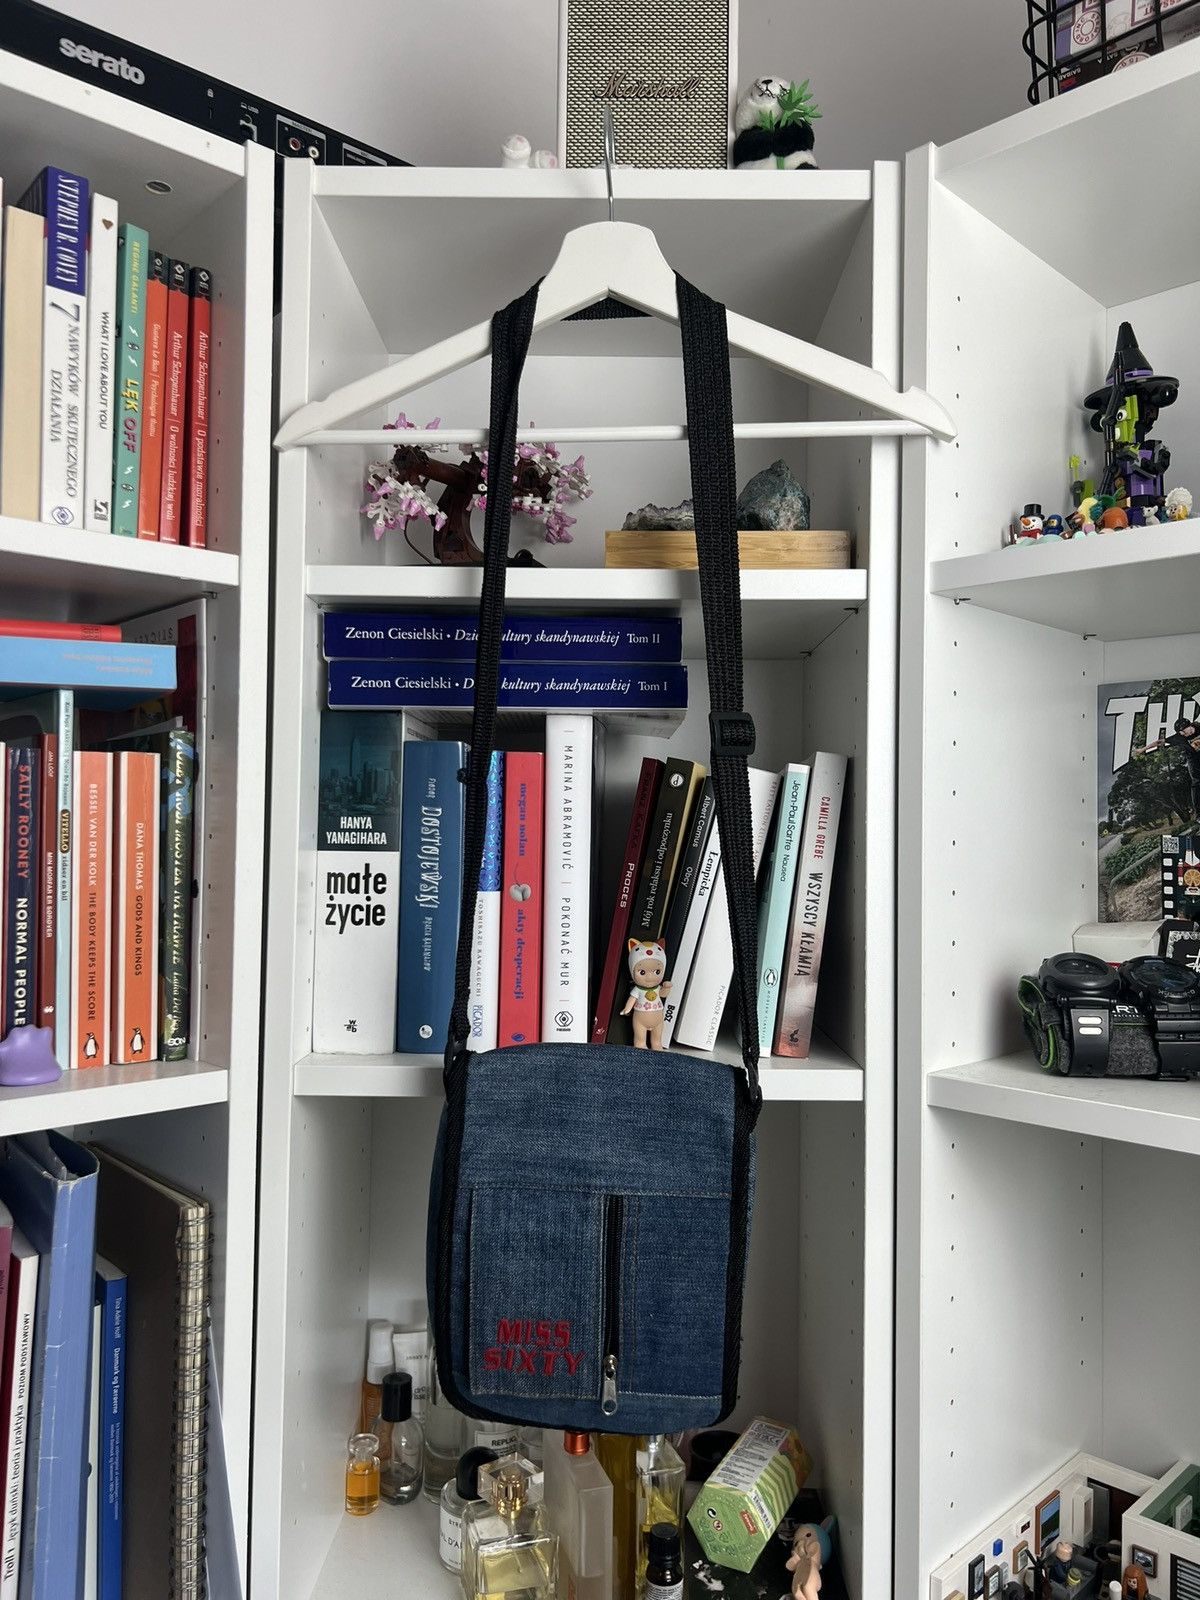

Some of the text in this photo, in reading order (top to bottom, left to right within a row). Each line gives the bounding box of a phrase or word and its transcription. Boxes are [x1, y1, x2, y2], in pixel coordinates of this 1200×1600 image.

[59, 37, 146, 85] serato
[593, 70, 701, 98] Marshall
[55, 174, 80, 286] STEPHEN R. COVEY
[100, 311, 110, 342] WHAT
[100, 347, 109, 371] LOVE
[50, 302, 83, 499] 7 NAWYKÓW SKUTECZNEGO
[99, 372, 109, 407] ABOUT
[99, 408, 108, 431] YOU
[121, 377, 140, 454] LĘK OFF
[165, 331, 184, 521] Arthur Schopenhauer O wolności ludzkiej woli
[194, 331, 209, 527] Arthur Schopenhauer O podstawie moralności
[345, 626, 384, 641] Zenon
[387, 626, 444, 642] Ciesielski
[534, 629, 621, 647] skandynawskiej
[627, 633, 649, 644] Tom
[651, 633, 661, 644] II
[350, 675, 392, 689] Zenon
[394, 676, 452, 690] Ciesielski
[500, 677, 542, 694] kultury
[544, 678, 631, 695] skandynawskiej
[637, 680, 660, 692] Tom
[663, 681, 668, 691] I
[339, 816, 373, 830] HANYA
[759, 799, 776, 827] EASTON
[61, 811, 70, 852] VITELLO
[326, 831, 389, 845] YANAGIHARA
[655, 811, 674, 861] odpoczynku
[680, 794, 711, 888] Albert Camus Obcy
[755, 826, 767, 847] ELLIS
[779, 779, 802, 882] Jean-Paul Sartre Nausea
[46, 852, 54, 865] MIN
[414, 804, 443, 909] DOSTOJEWSKI
[558, 745, 574, 987] MARINA ABRAMOVIĆ POKONAĆ MUR
[46, 866, 54, 894] MORFAR
[326, 862, 388, 895] małe
[511, 782, 529, 999] megan nolan akty desperacji
[619, 861, 636, 910] PROCES
[648, 864, 663, 892] relaksu
[697, 850, 720, 898] Łempicka
[793, 795, 832, 978] CAMILLA GREBE WSZYSCY KŁAMIĄ
[14, 764, 32, 1025] SALLY ROONEY NORMAL PEOPLE
[46, 895, 54, 905] ER
[61, 890, 69, 902] bil
[87, 783, 99, 1021] BESSEL VAN DER KOLK THE BODY KEEPS THE SCORE
[134, 822, 146, 977] DANA THOMAS GODS AND KINGS
[646, 894, 657, 911] rok
[325, 895, 388, 935] życie
[640, 911, 654, 928] Mój
[471, 898, 485, 1038] TOSHIKAZU KAWAGUCHI PICADOR
[705, 984, 727, 1045] PICADOR CLASSIC
[763, 990, 772, 1014] MODERN
[18, 1312, 31, 1368] PODSTAWOWY
[495, 1316, 572, 1349] MISS
[112, 1347, 122, 1376] Danmark
[480, 1347, 588, 1377] SIXTY
[18, 1368, 28, 1400] POZIOM
[111, 1376, 119, 1386] og
[12, 1404, 26, 1446] praktyka
[11, 1452, 21, 1481] teoria
[8, 1481, 20, 1516] duński:
[3, 1554, 15, 1582] Troll
